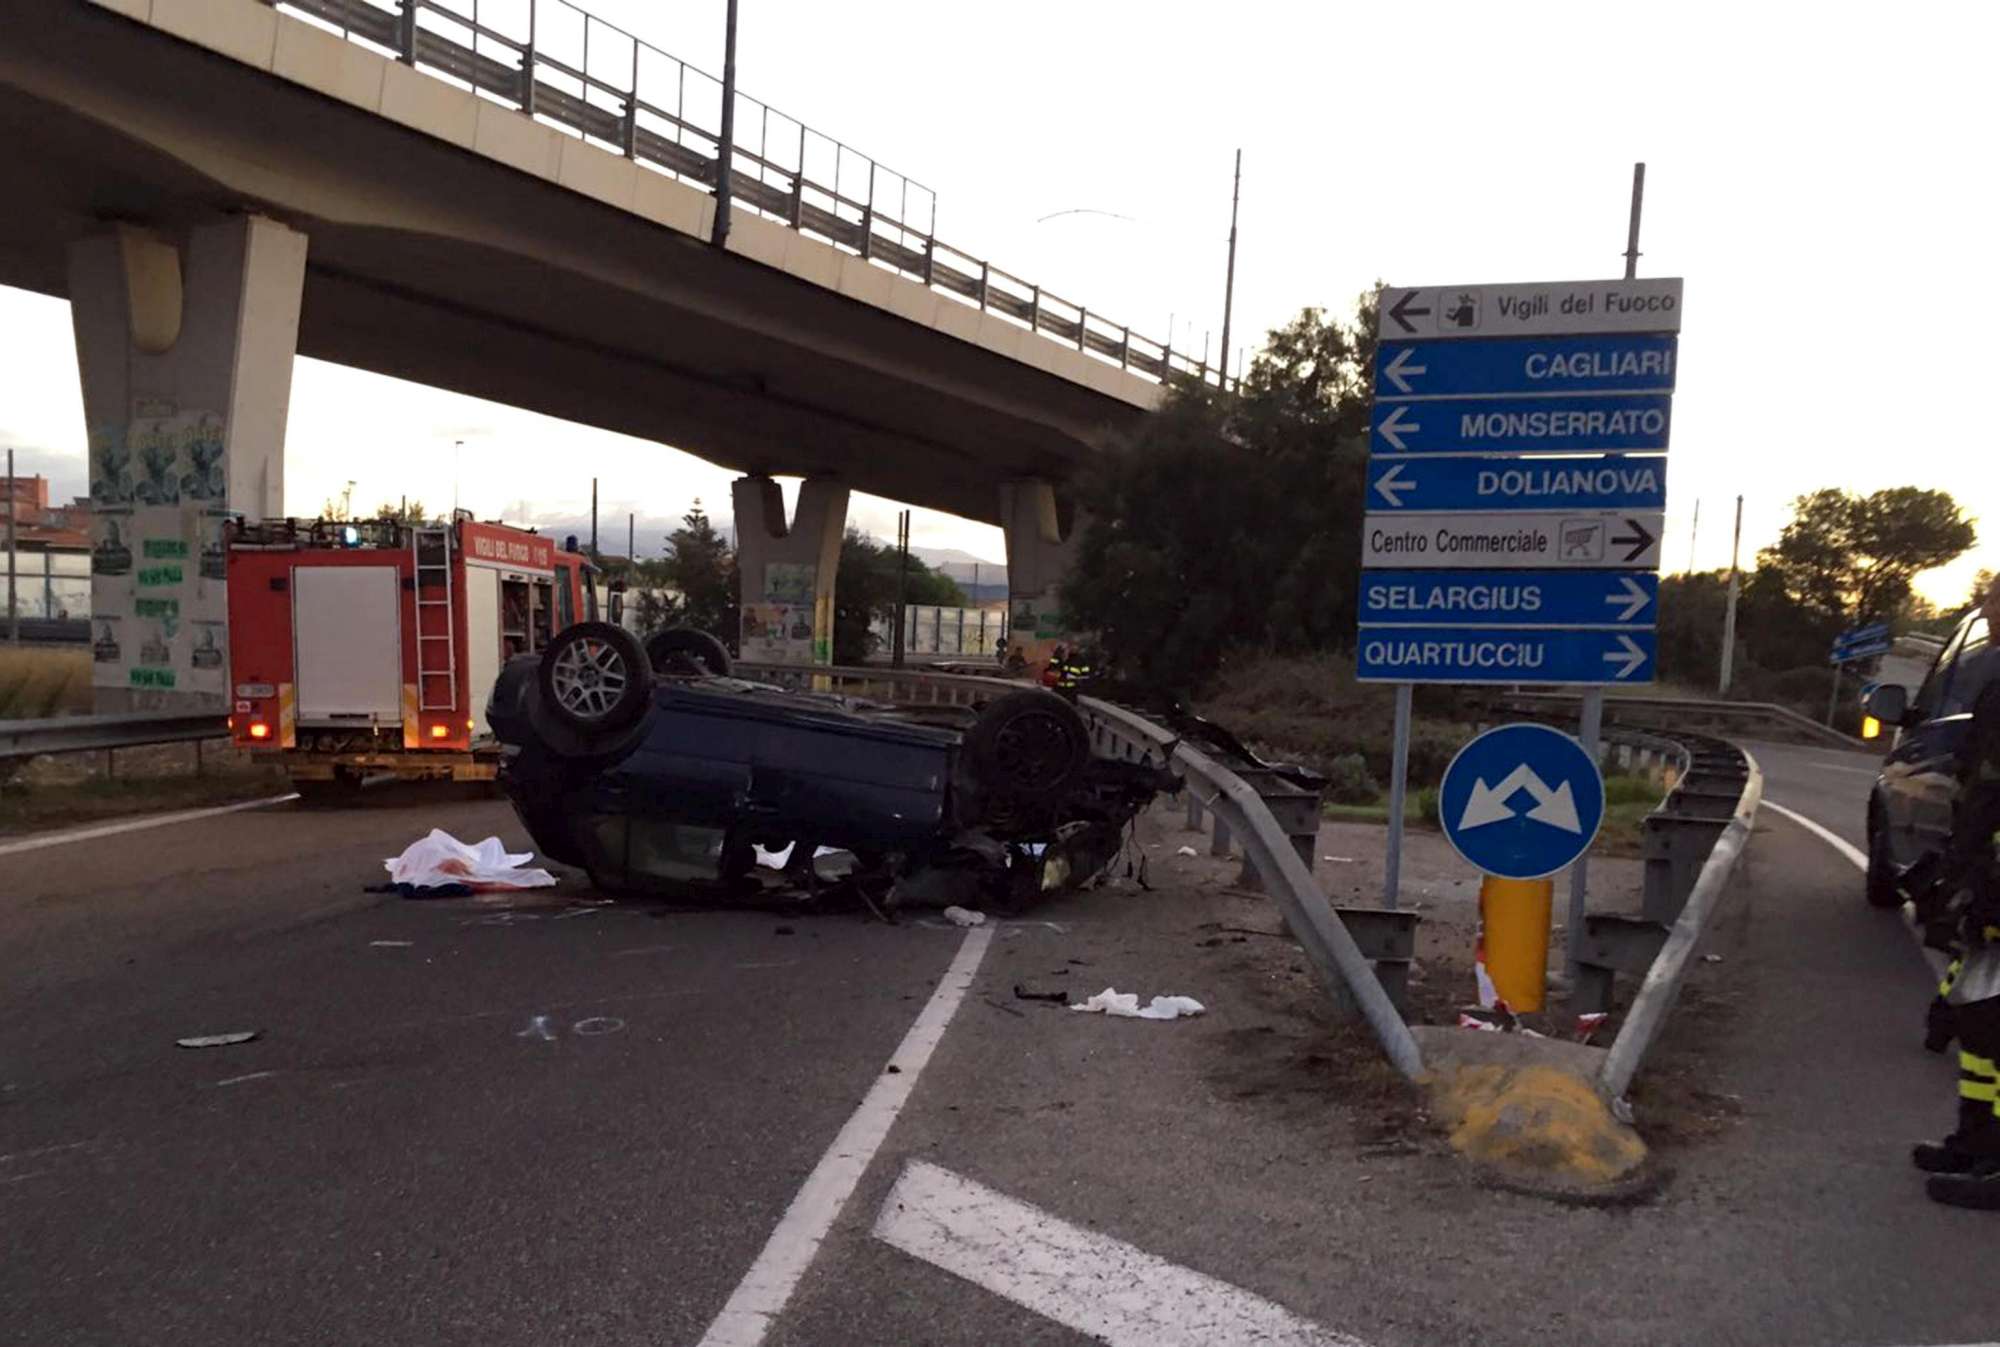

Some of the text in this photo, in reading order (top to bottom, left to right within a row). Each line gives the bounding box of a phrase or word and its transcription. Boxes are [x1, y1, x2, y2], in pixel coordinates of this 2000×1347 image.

[1498, 292, 1676, 320] Vigili del Fuoco
[1525, 351, 1671, 379] CAGLIARI
[1461, 409, 1665, 438] MONSERRATO
[1477, 469, 1659, 496] DOLIANOVA
[473, 536, 495, 557] VIGILI
[495, 540, 508, 560] DEL
[1371, 529, 1548, 554] Centro Commerciale
[1367, 586, 1542, 611] SELARGIUS
[1364, 641, 1545, 668] QUARTUCCIU
